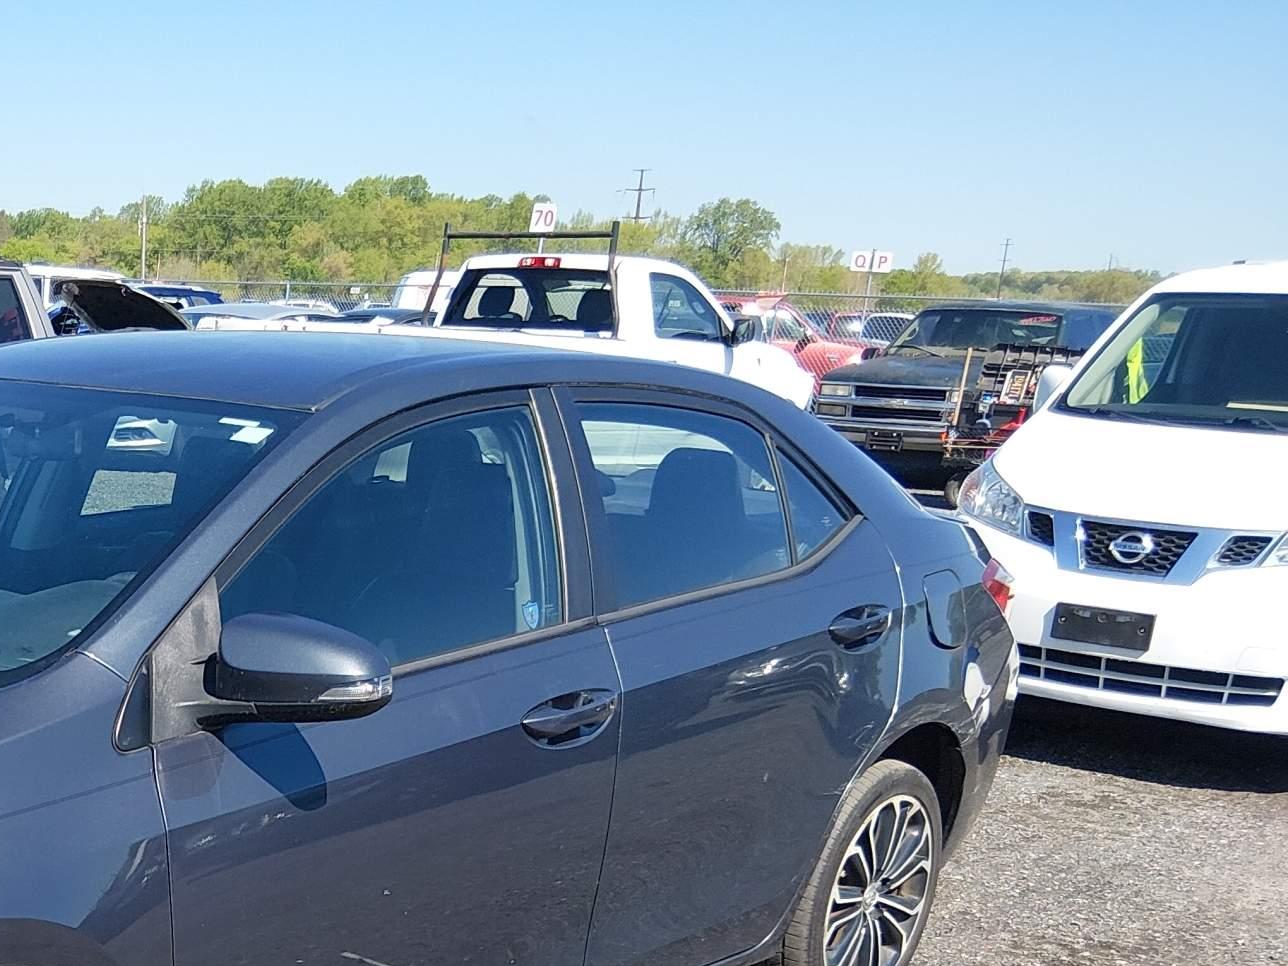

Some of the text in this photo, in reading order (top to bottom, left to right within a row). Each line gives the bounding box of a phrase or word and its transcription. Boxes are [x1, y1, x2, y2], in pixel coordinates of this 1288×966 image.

[534, 209, 554, 227] 70
[854, 254, 888, 269] Q P
